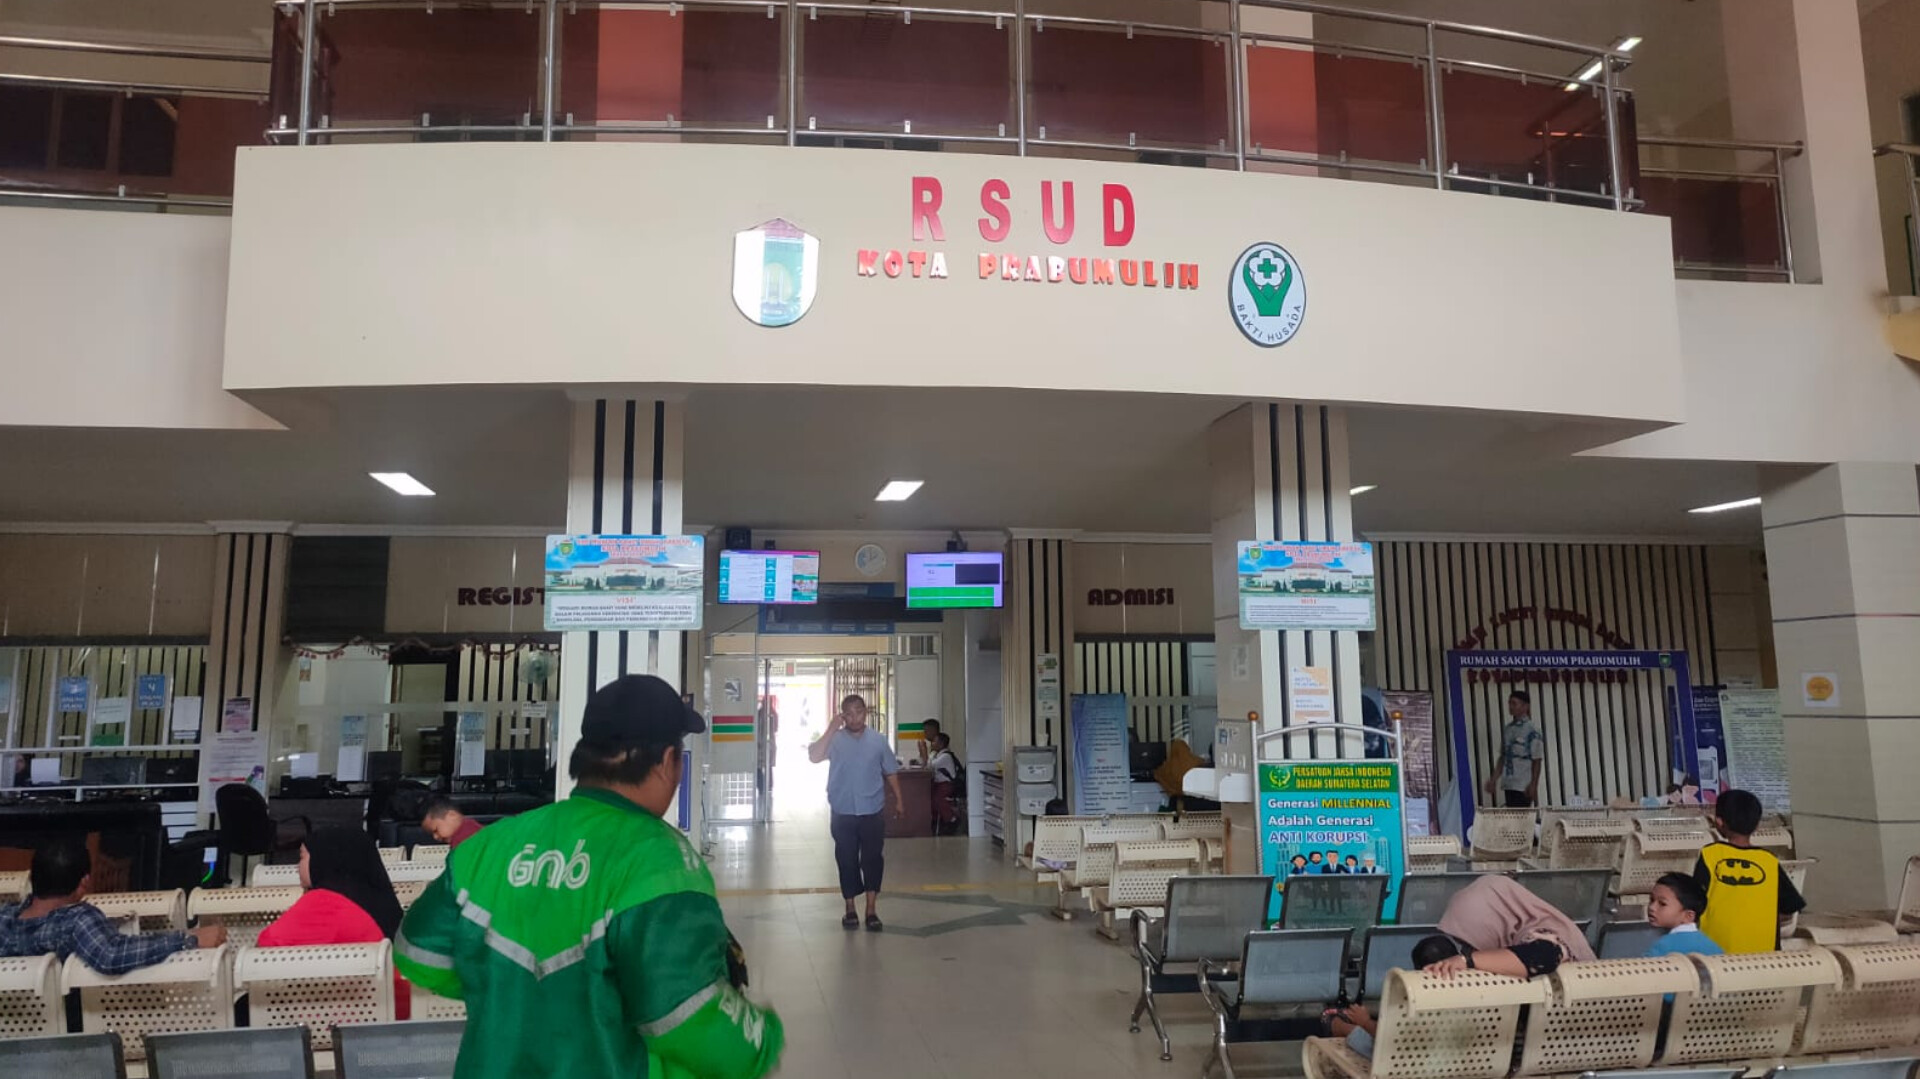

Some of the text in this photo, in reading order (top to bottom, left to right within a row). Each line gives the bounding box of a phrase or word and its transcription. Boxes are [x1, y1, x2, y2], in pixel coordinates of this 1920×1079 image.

[911, 175, 1136, 247] RSUD
[857, 249, 949, 279] KOTA
[1236, 303, 1302, 342] BAKTI HUSADA
[1088, 587, 1175, 606] ADMISI
[1459, 655, 1641, 666] RUMAH SAKIT UMUM PRABUMULIH
[1293, 766, 1332, 777] PERSATUAN
[1355, 766, 1392, 777] INDONESIA
[1295, 778, 1390, 789] DAERAH SUMATERA SELATAN
[1267, 798, 1392, 809] Generasi MILLENNIAL
[1267, 815, 1374, 826] Adalah Generasi
[1269, 831, 1368, 843] ANTI KORUPSI
